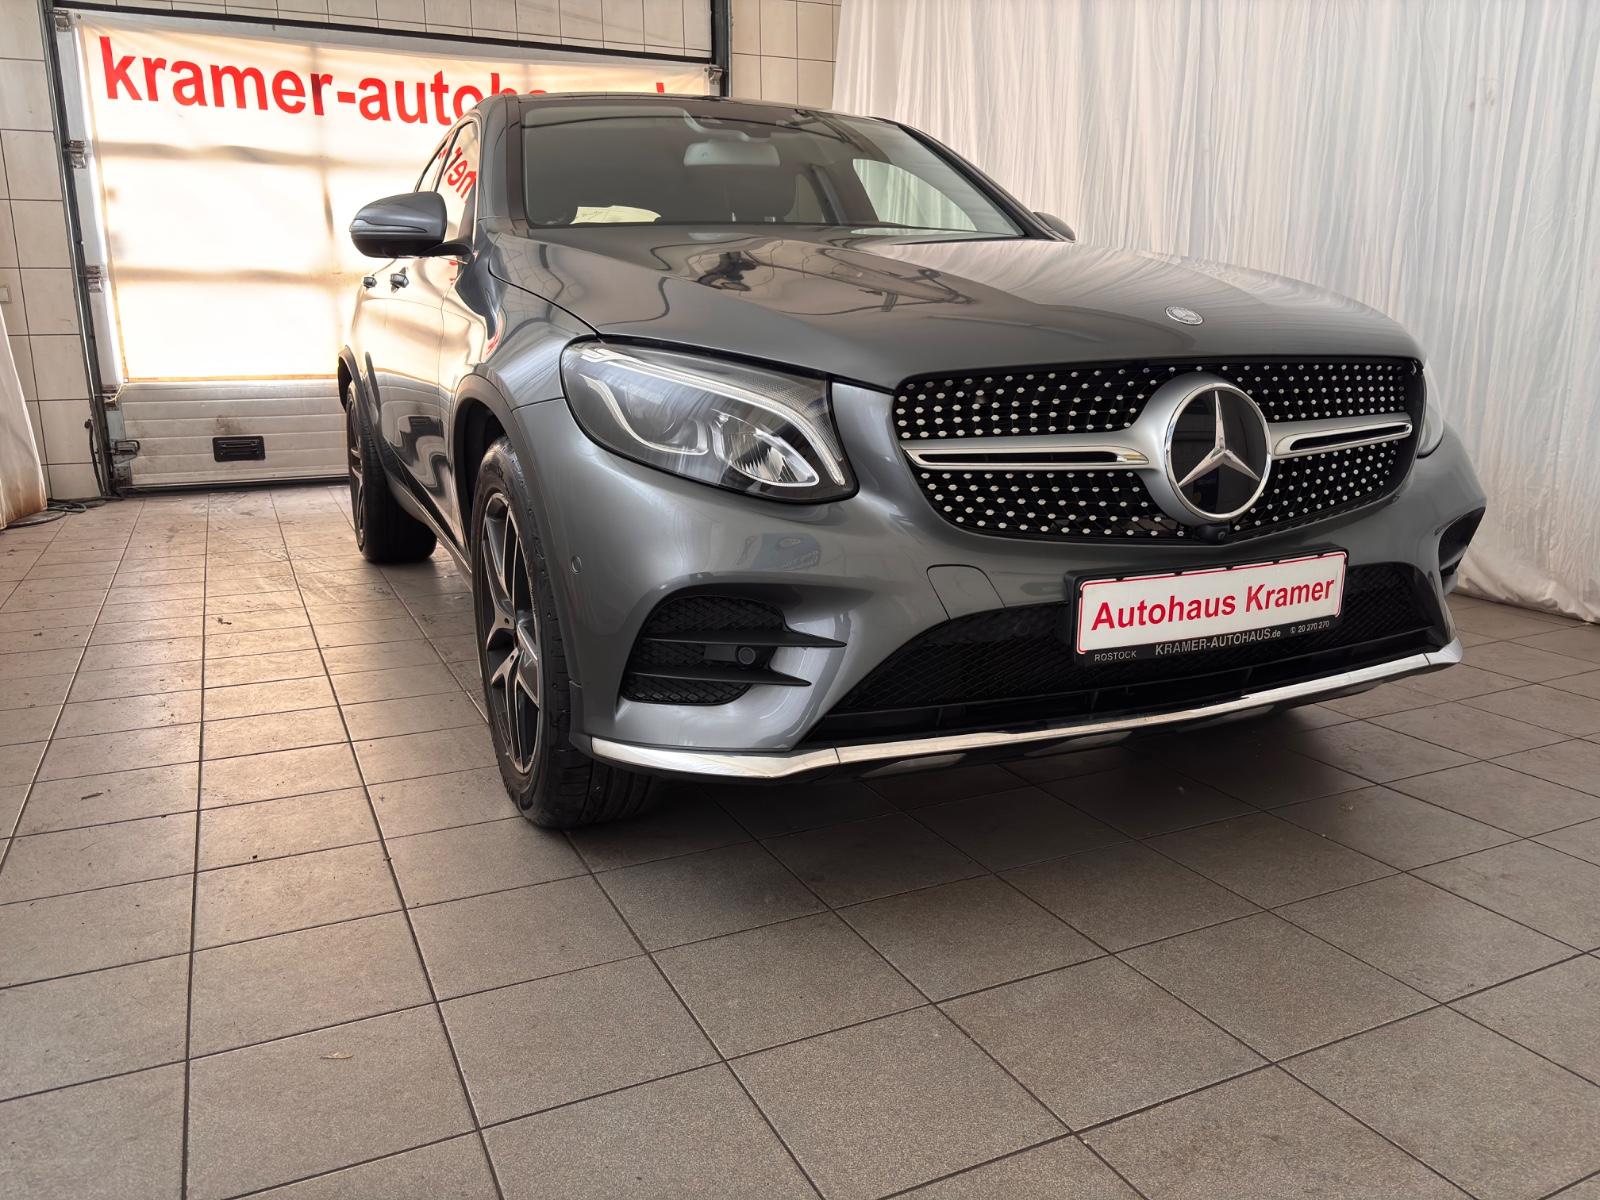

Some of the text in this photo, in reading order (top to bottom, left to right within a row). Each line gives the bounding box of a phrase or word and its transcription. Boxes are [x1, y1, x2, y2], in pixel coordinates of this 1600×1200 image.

[98, 35, 666, 127] kramer-auto
[1092, 579, 1335, 632] Autohaus Kramer
[1094, 620, 1330, 662] ROSTOCK KRAMER-AUTOHAUS.de 20 270 270
